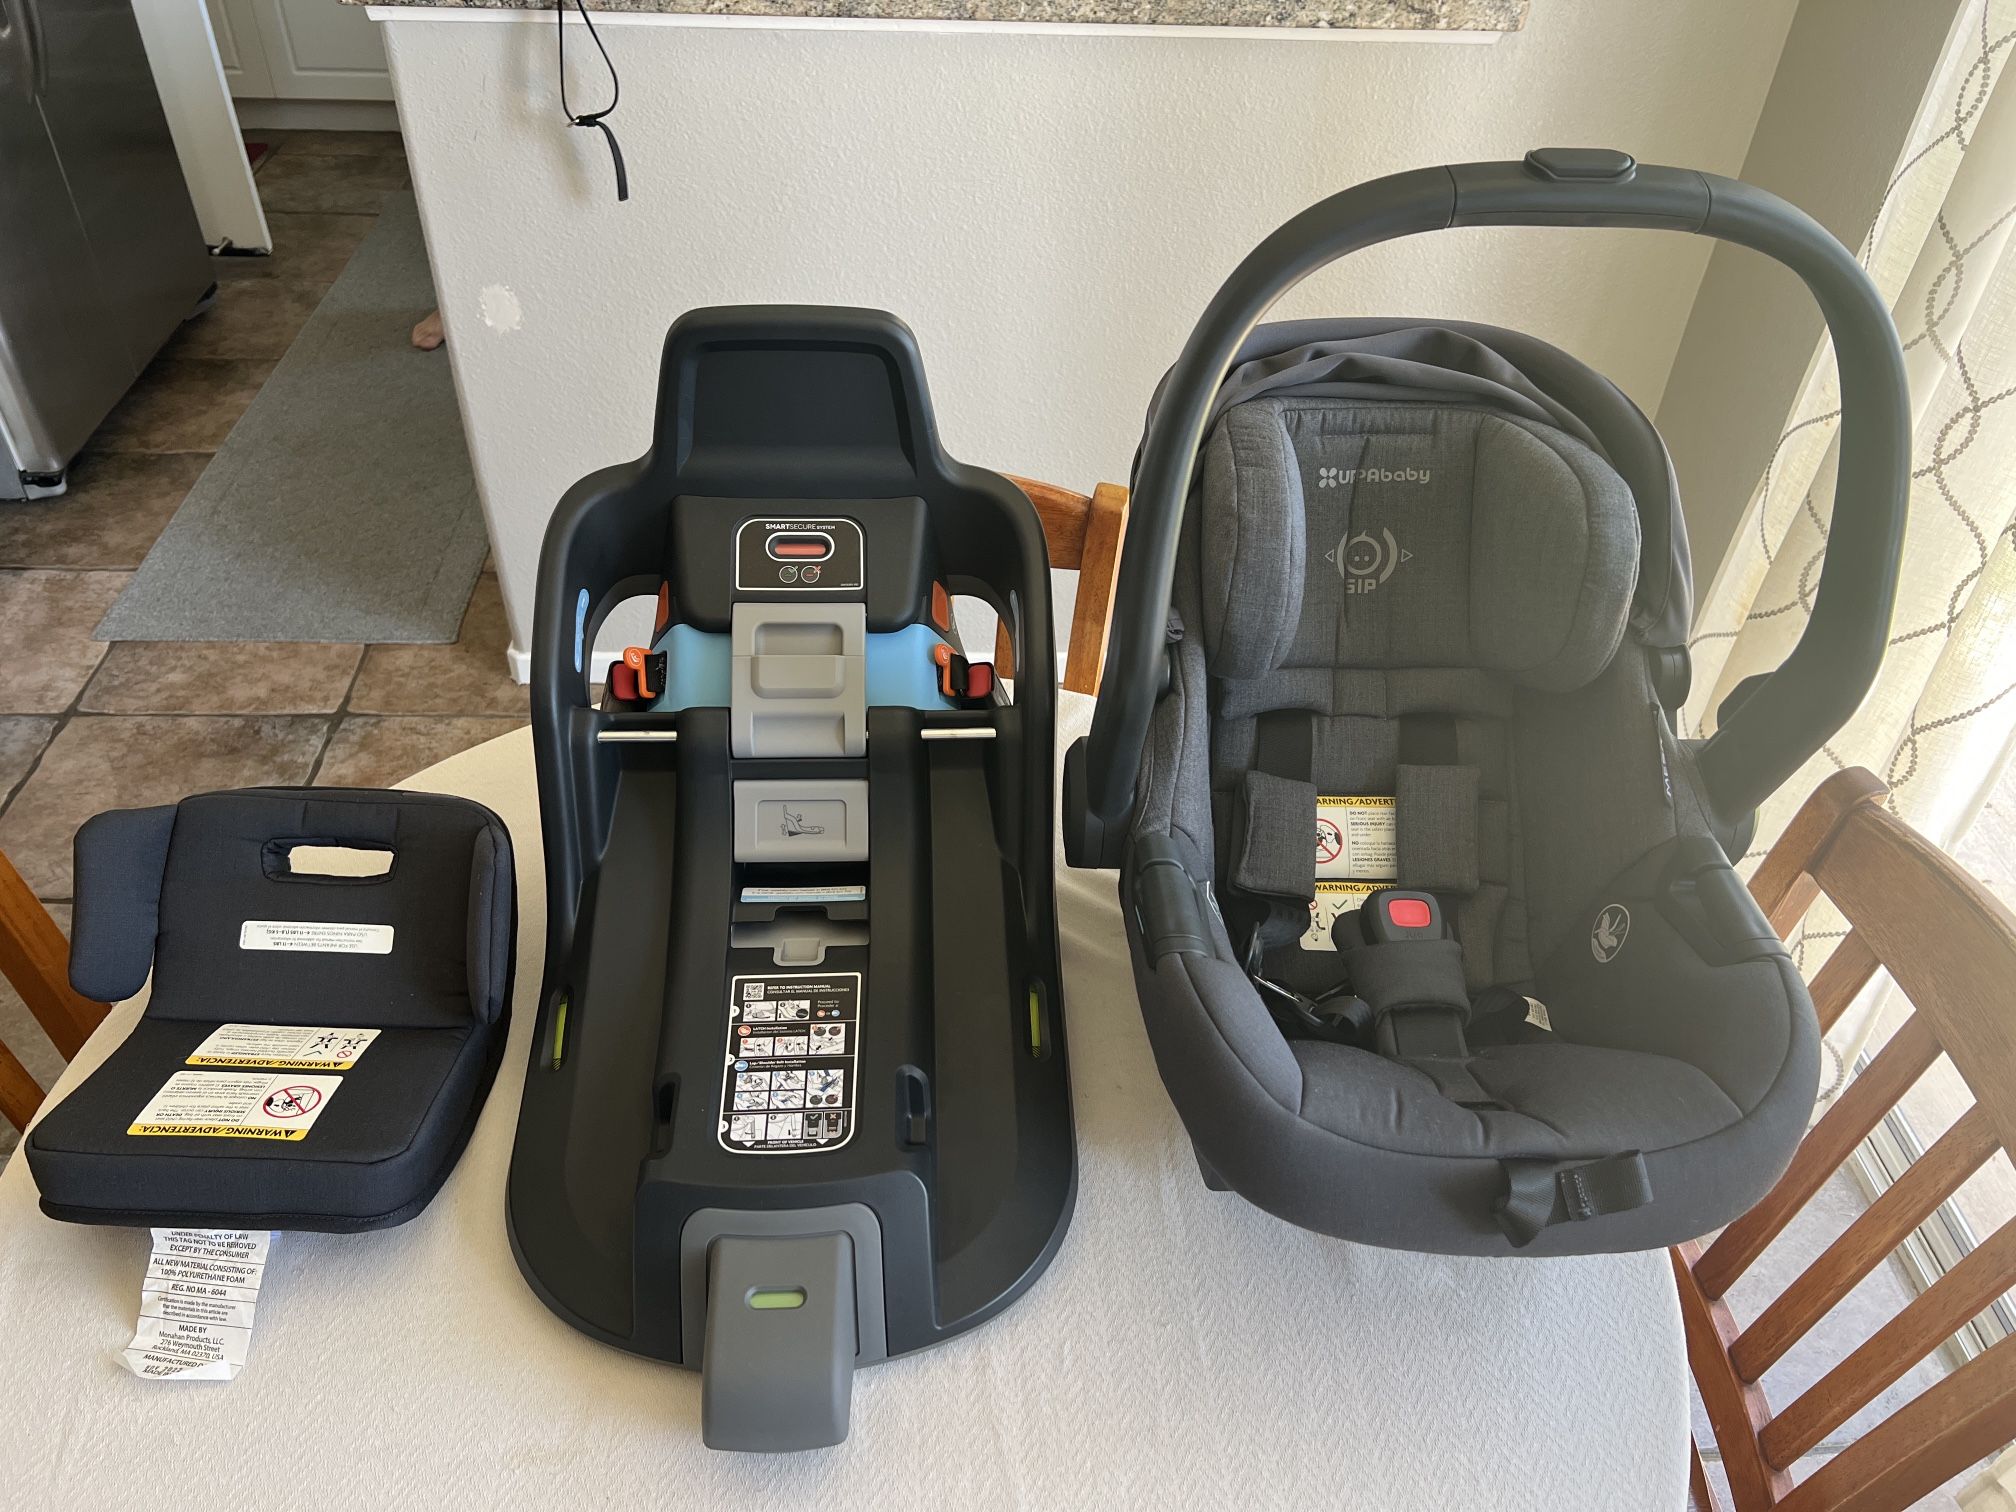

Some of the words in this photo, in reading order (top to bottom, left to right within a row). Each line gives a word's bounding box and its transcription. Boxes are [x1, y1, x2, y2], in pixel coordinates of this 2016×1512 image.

[1346, 579, 1376, 593] SIP
[170, 1244, 192, 1253] EXCEPT
[215, 1249, 250, 1259] CONSUMER
[227, 1242, 257, 1250] REMOVED
[153, 1257, 164, 1266] ALL
[165, 1259, 180, 1267] NEW
[180, 1261, 209, 1270] MATERIAL
[209, 1264, 246, 1275] CONSISTING
[161, 1268, 177, 1276] 100%
[177, 1270, 226, 1282] POLYURETHANE
[226, 1276, 245, 1284] FOAM
[171, 1284, 185, 1292] REG.
[196, 1287, 207, 1295] MA
[159, 1331, 185, 1340] Monahan
[178, 1325, 198, 1333] MADE
[198, 1326, 207, 1334] BY
[160, 1338, 172, 1346] 276
[172, 1340, 202, 1351] Weymouth
[144, 1354, 197, 1367] MANUFACTURED
